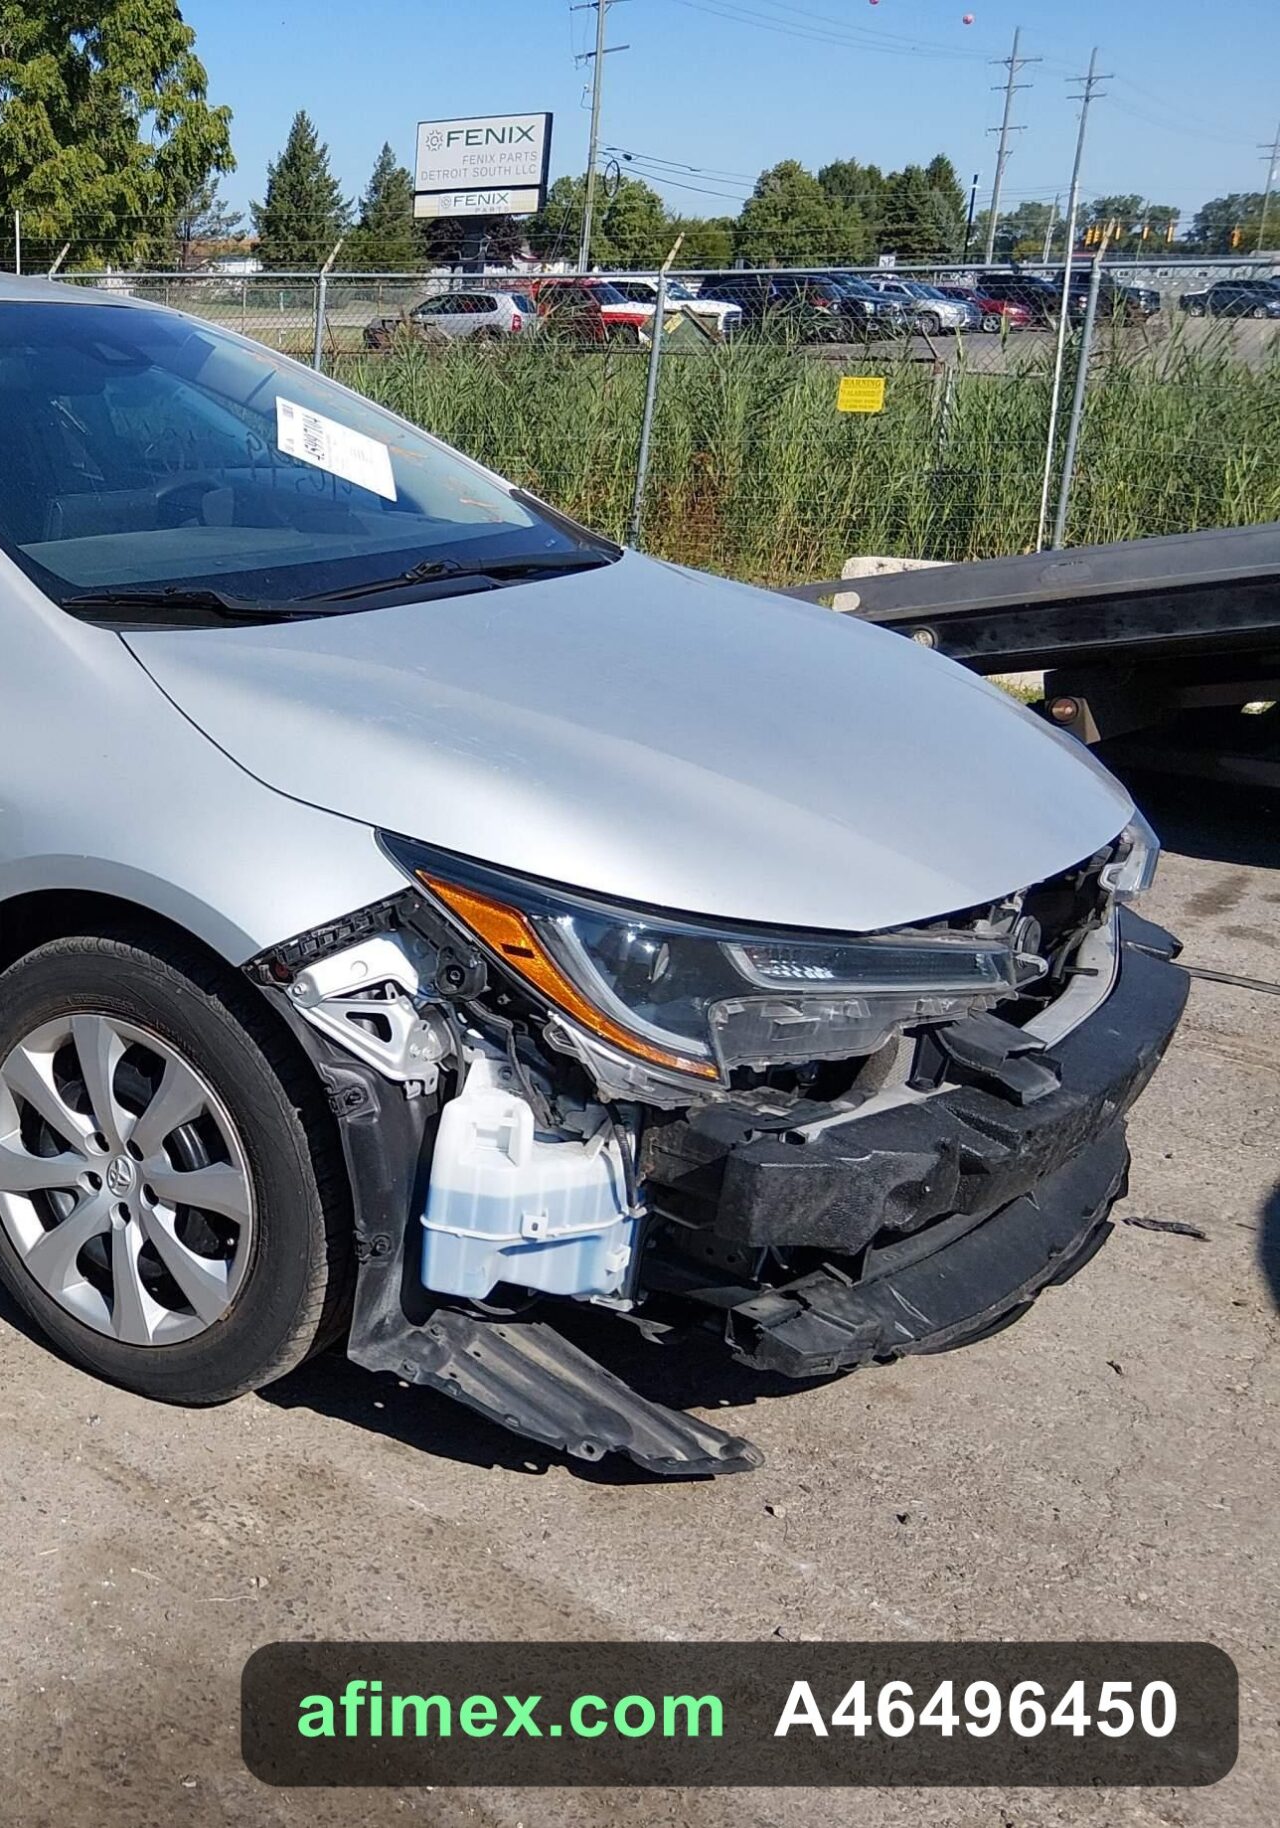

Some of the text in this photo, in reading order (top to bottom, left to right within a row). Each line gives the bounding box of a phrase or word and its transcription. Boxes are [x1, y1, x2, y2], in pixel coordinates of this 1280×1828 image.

[446, 125, 536, 148] FENIX
[462, 151, 538, 165] FENIX PARTS
[421, 164, 537, 181] DETROIT SOUTH LLC
[453, 192, 509, 207] FENIX
[842, 379, 881, 388] WARNING
